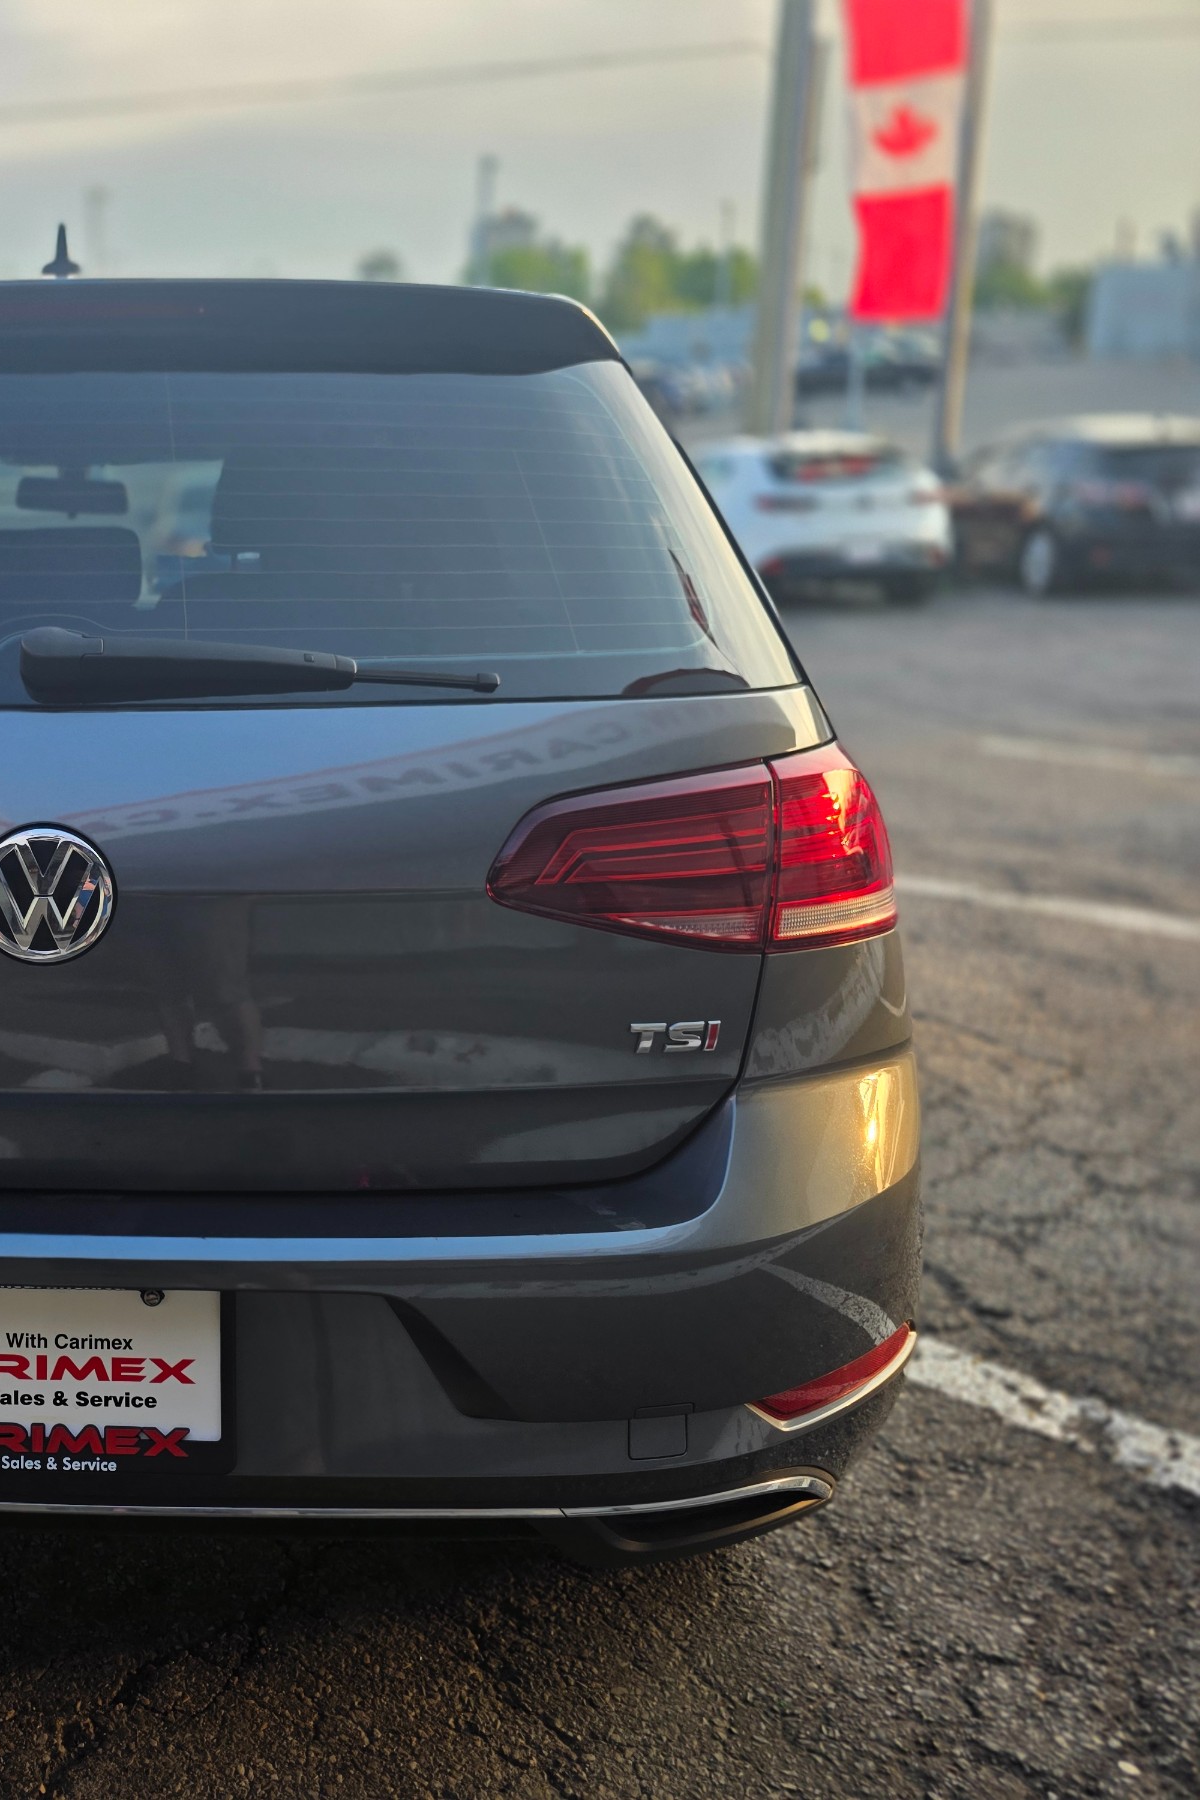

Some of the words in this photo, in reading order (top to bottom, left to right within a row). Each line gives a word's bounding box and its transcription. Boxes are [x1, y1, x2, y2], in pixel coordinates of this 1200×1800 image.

[630, 1020, 721, 1054] TSI
[5, 1332, 48, 1349] With
[53, 1333, 133, 1350] Carimex
[52, 1391, 69, 1407] &
[75, 1391, 158, 1409] Service
[1, 1455, 42, 1470] Sales
[46, 1456, 58, 1471] &
[62, 1457, 117, 1472] Service
